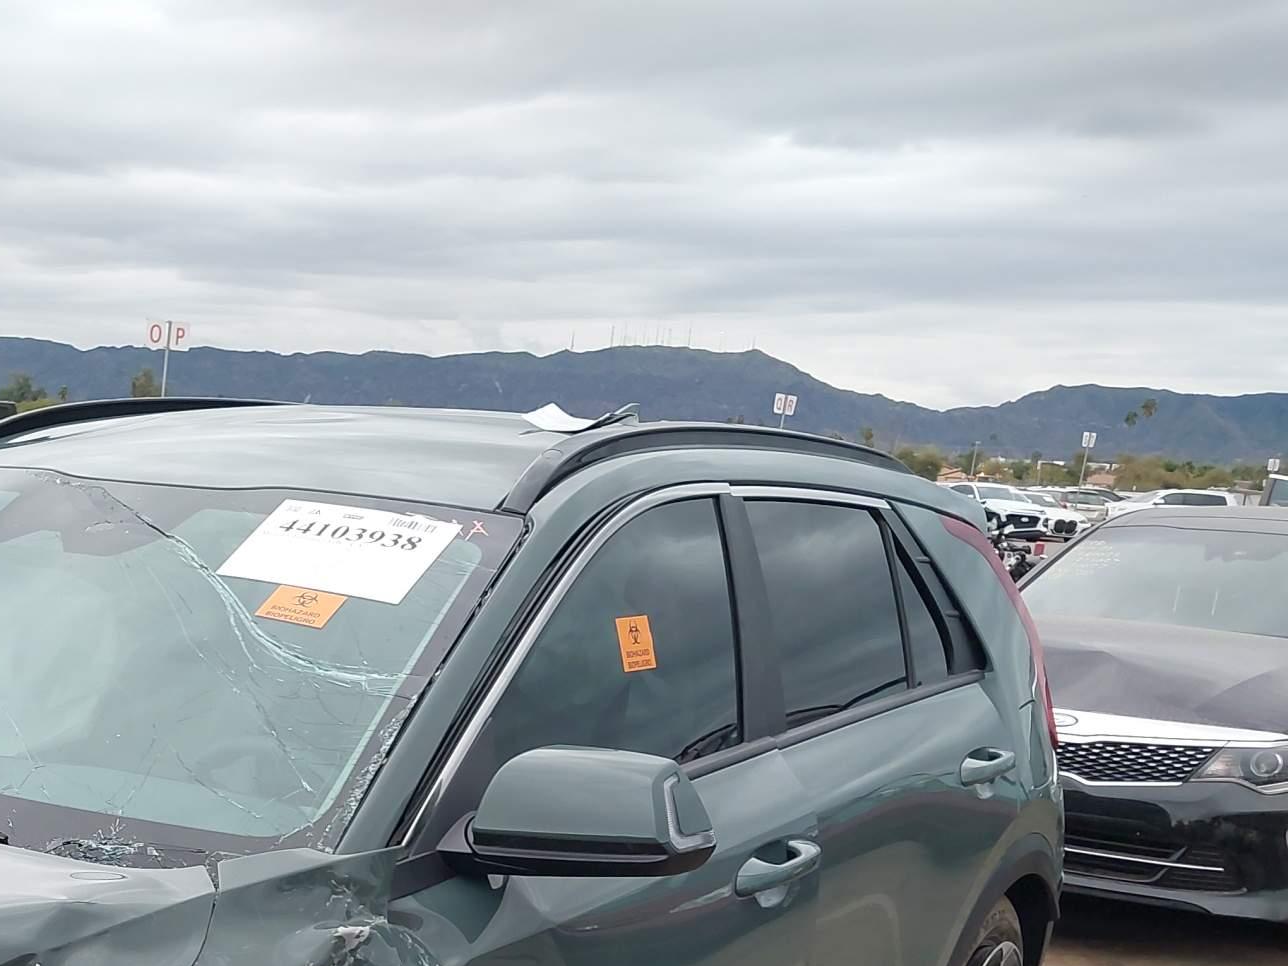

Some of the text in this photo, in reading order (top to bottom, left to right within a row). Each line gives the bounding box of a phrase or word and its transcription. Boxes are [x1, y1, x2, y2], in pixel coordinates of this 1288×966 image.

[176, 327, 185, 346] P
[279, 519, 423, 551] 44103938
[264, 611, 316, 625] BIOPELIGRO
[270, 605, 321, 618] BIOHAZARD
